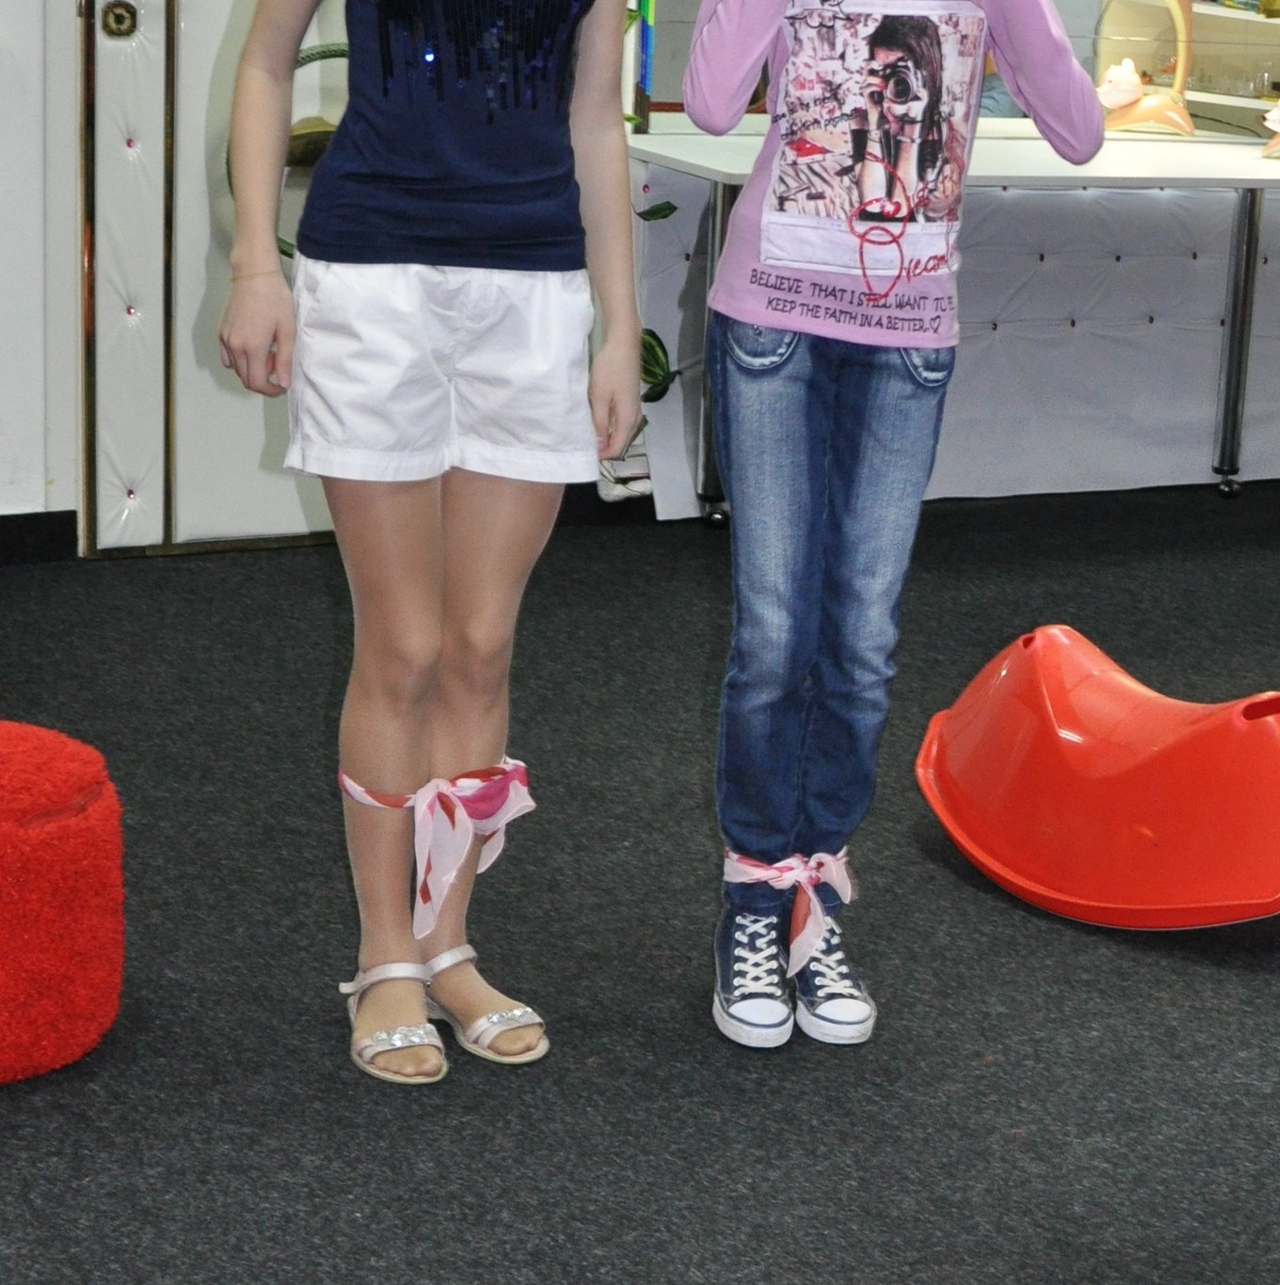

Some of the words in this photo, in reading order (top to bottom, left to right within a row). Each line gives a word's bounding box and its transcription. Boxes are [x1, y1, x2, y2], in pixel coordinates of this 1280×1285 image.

[749, 268, 803, 294] BELIEVE
[810, 282, 847, 302] THAT
[848, 290, 855, 305] I
[856, 291, 892, 309] STILL
[894, 293, 929, 312] WANT
[765, 296, 797, 314] KEEP
[799, 302, 821, 319] THE
[823, 307, 858, 325] FAITH
[859, 313, 873, 328] IN
[874, 315, 884, 330] A
